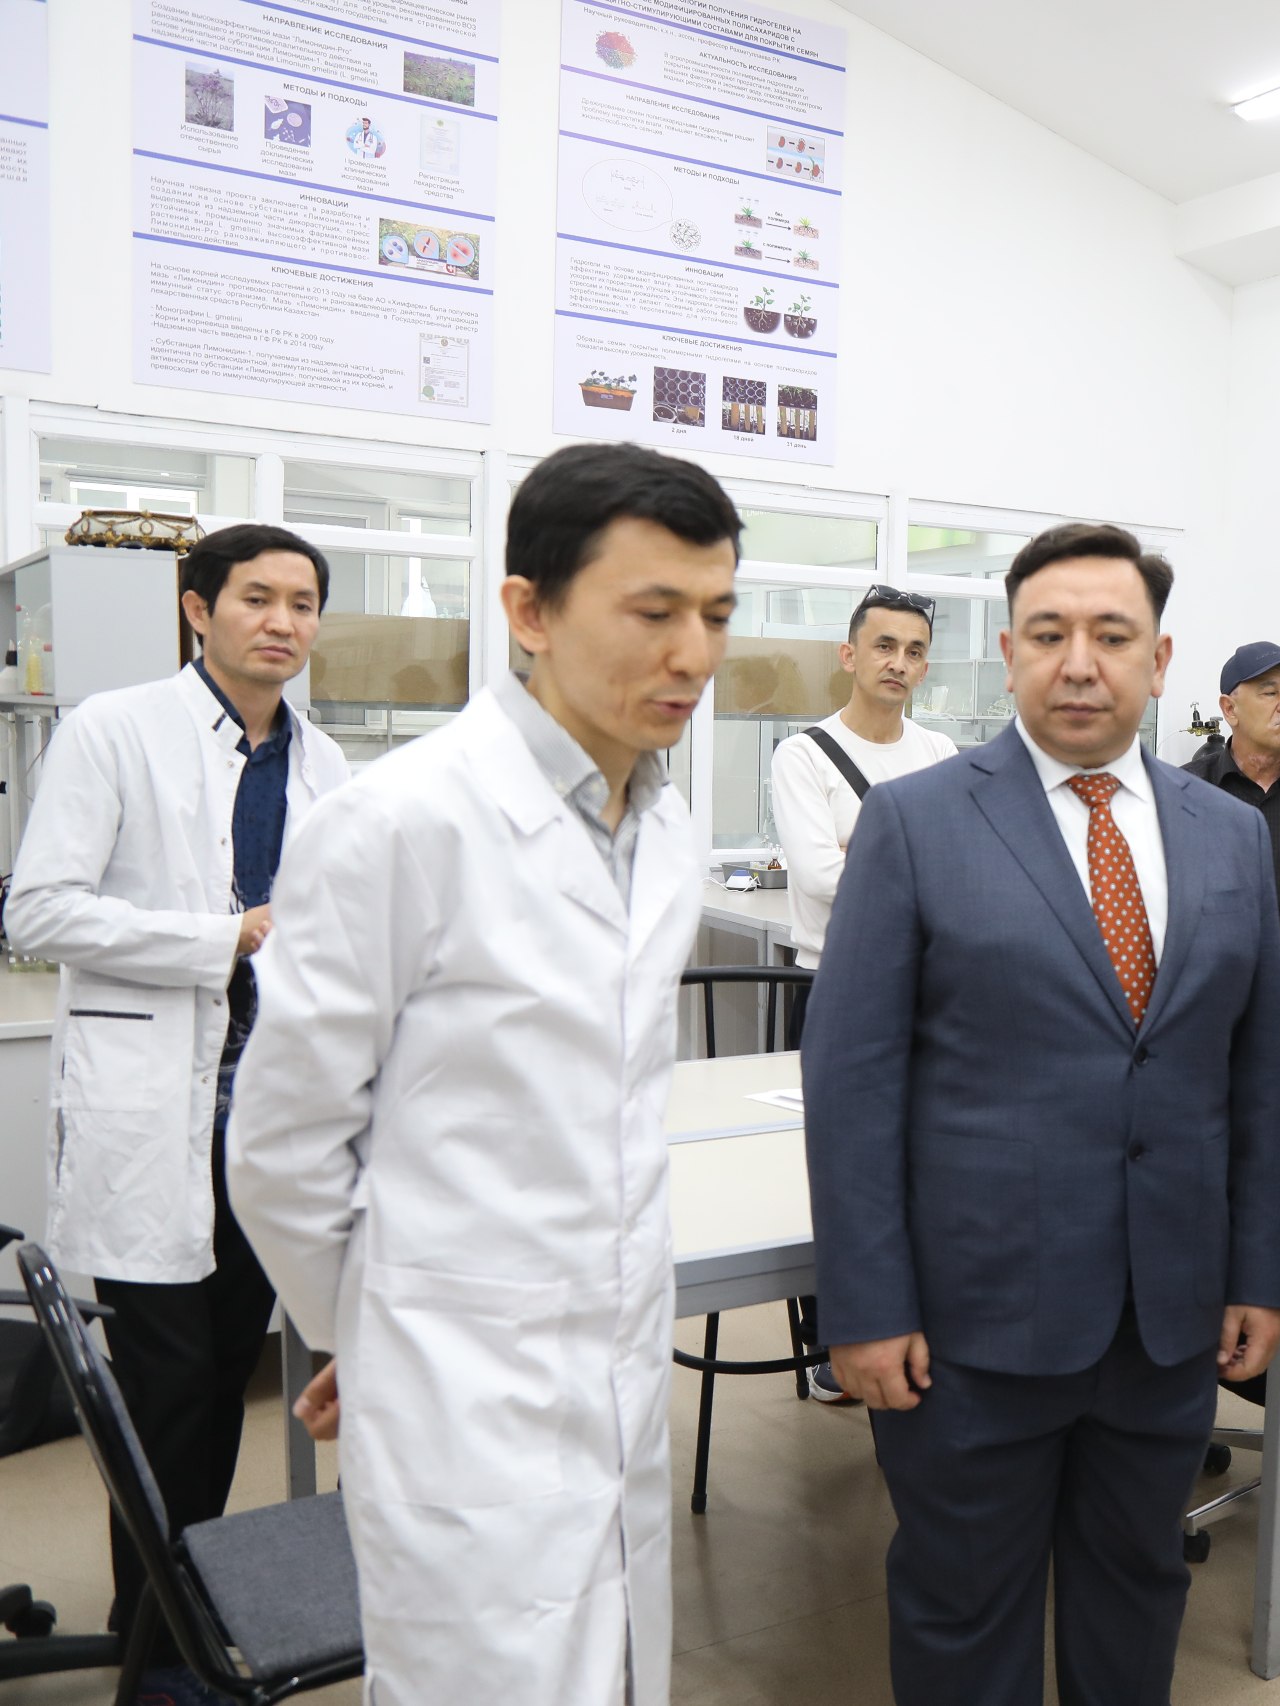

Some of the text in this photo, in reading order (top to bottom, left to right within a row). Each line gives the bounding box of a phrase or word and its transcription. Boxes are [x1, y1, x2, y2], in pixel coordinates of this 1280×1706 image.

[461, 22, 477, 30] ВОЗ
[583, 6, 612, 19] Научный
[697, 37, 728, 51] профессор
[654, 0, 789, 40] МОДИФИЦИРОВАННЫХ ПОЛИСАХАРИДОВ
[708, 4, 748, 20] ПОЛУЧЕНИЯ
[750, 15, 791, 32] ГИДРОГЕЛЕЙ
[262, 13, 387, 50] НАПРАВЛЕНИЕ ИССЛЕДОВАНИЯ
[703, 23, 819, 59] СОСТАВАМИ ДЛЯ ПОКРЫТИЯ СЕМЯН
[283, 82, 367, 107] МЕТОДЫ И ПОДХОДЫ
[673, 165, 701, 177] МЕТОДЫ
[708, 173, 739, 185] ПОДХОДЫ
[299, 193, 348, 208] ИННОВАЦИИ
[271, 265, 373, 288] КЛЮЧЕВЫЕ ДОСТИЖЕНИЯ
[684, 266, 723, 278] ИННОВАЦИИ
[662, 334, 742, 352] КЛЮЧЕВЫЕ ДОСТИЖЕНИЯ
